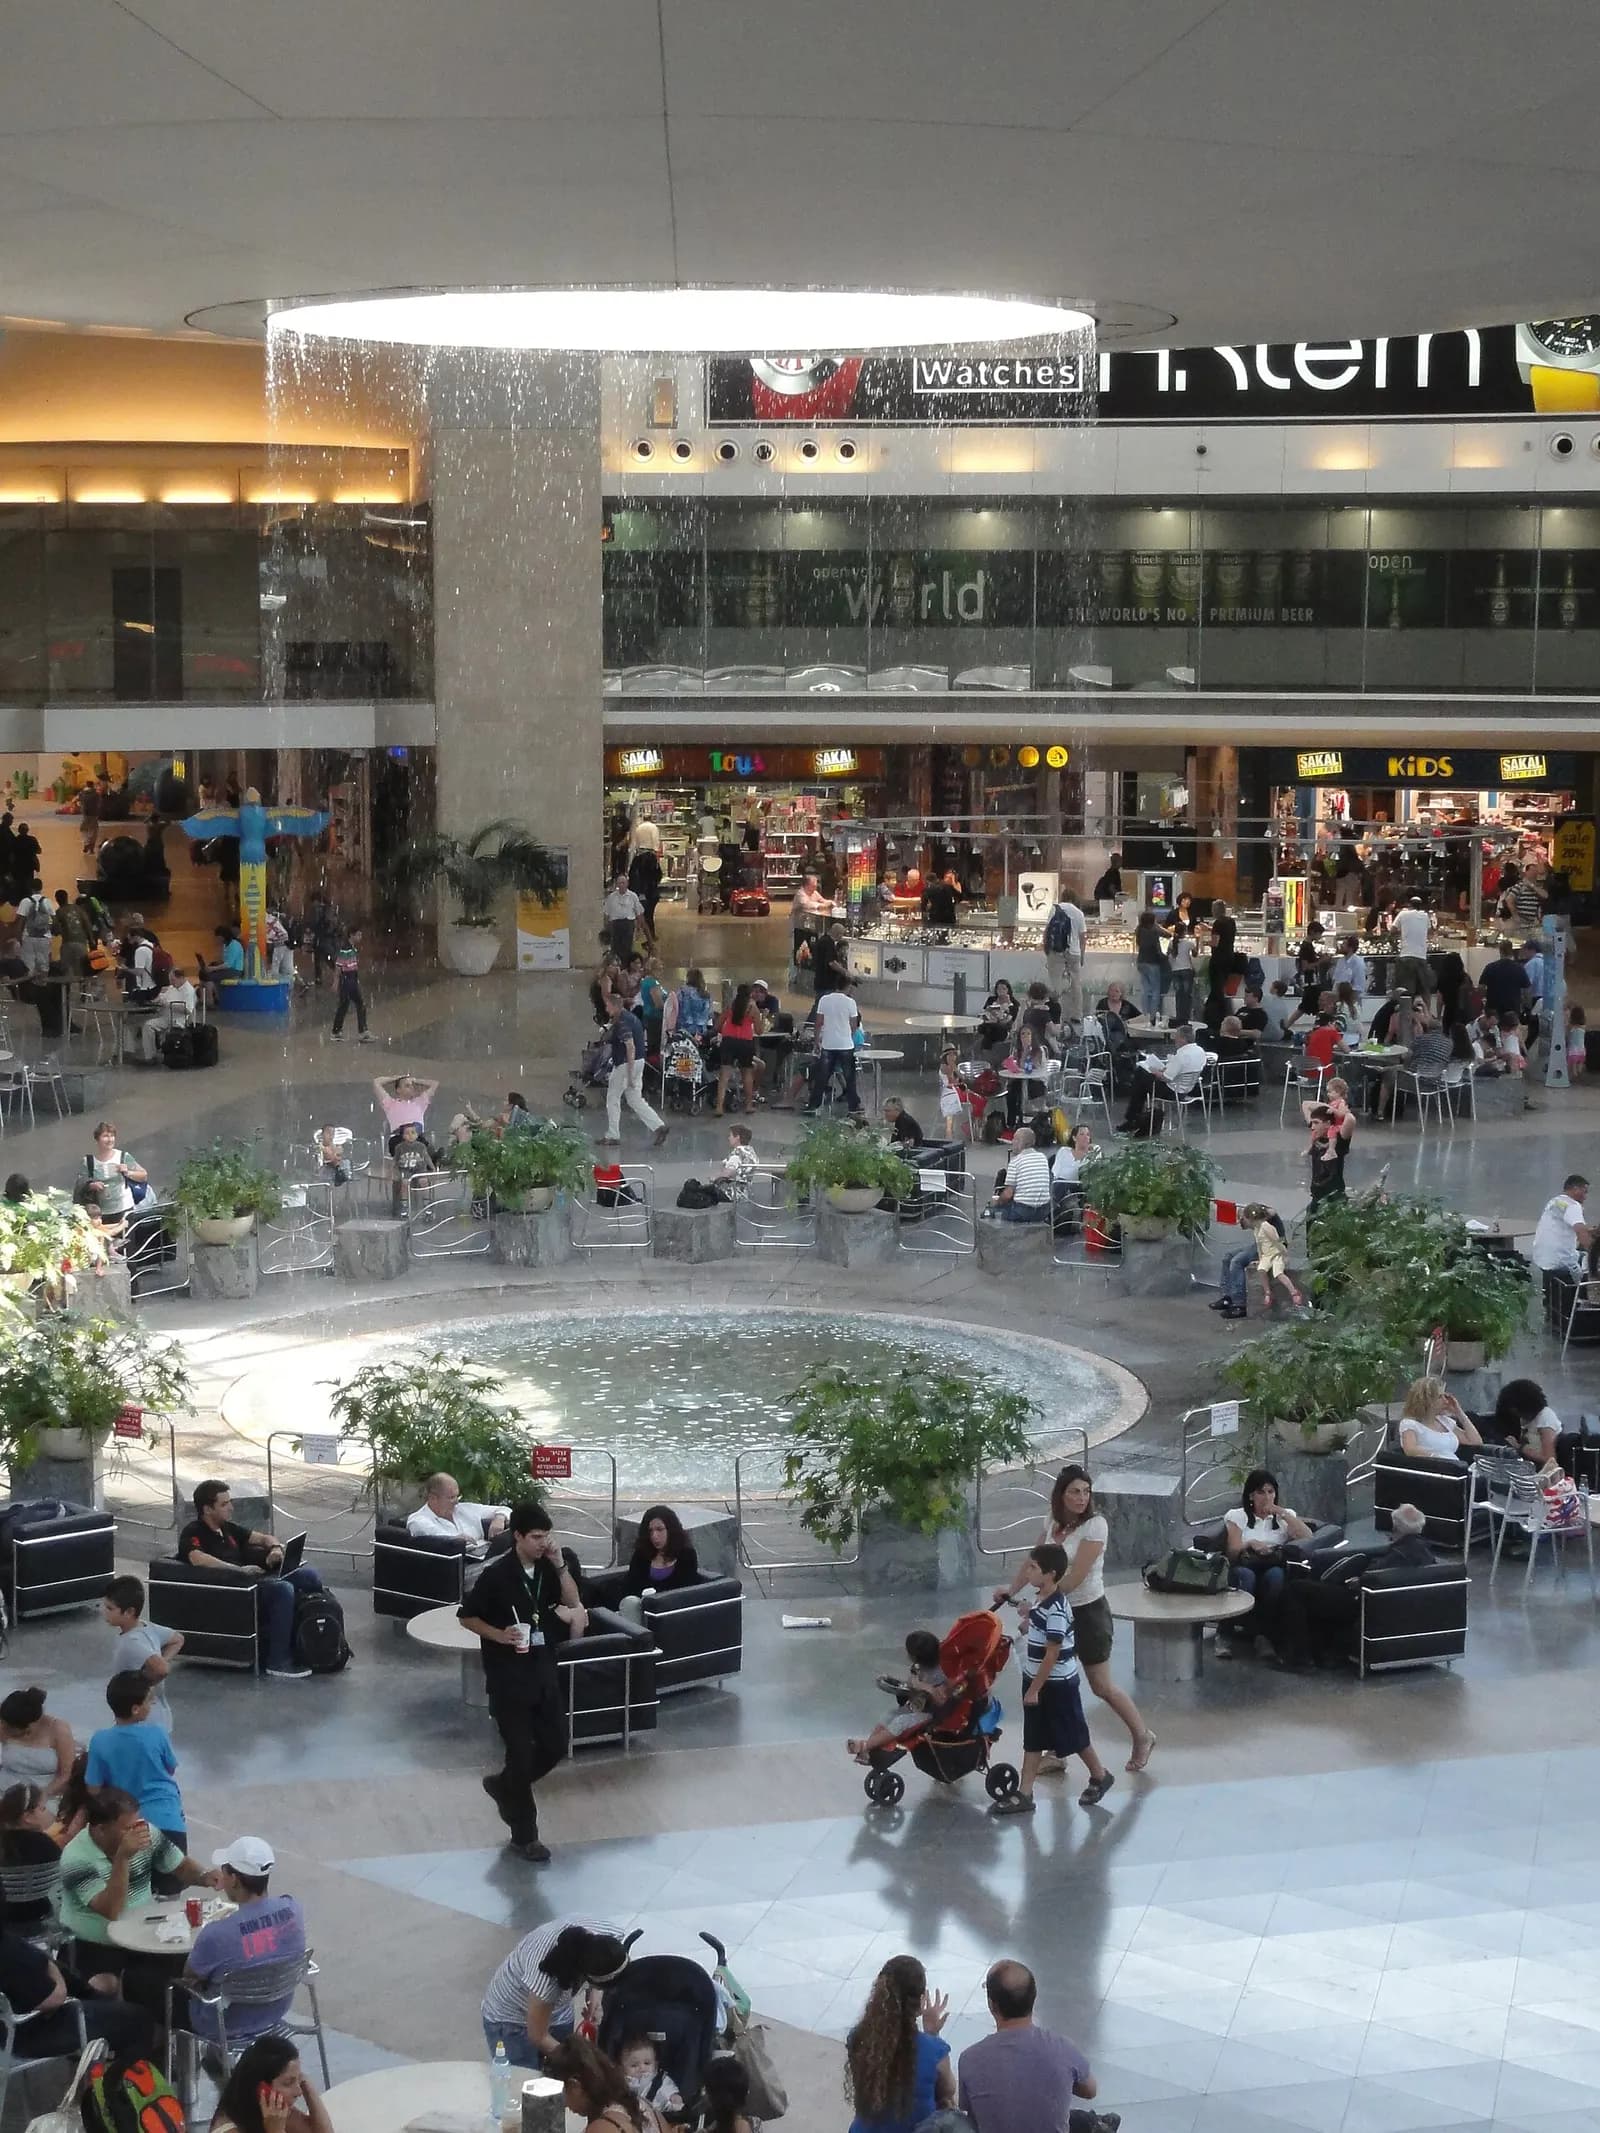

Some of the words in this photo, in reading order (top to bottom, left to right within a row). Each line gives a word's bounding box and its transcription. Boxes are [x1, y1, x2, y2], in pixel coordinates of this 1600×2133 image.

[920, 361, 1075, 385] Watches
[1368, 554, 1411, 572] open
[1100, 607, 1161, 621] WORLD'S
[1210, 608, 1275, 621] PREMIUM
[1282, 608, 1313, 621] BEER
[621, 750, 661, 767] SAKAL
[815, 749, 855, 767] SAKAL
[1300, 753, 1339, 769] SAKAL
[1503, 756, 1543, 771] SAKAL
[1561, 832, 1591, 845] sale
[1561, 847, 1586, 859] 20%
[259, 1914, 273, 1930] TO
